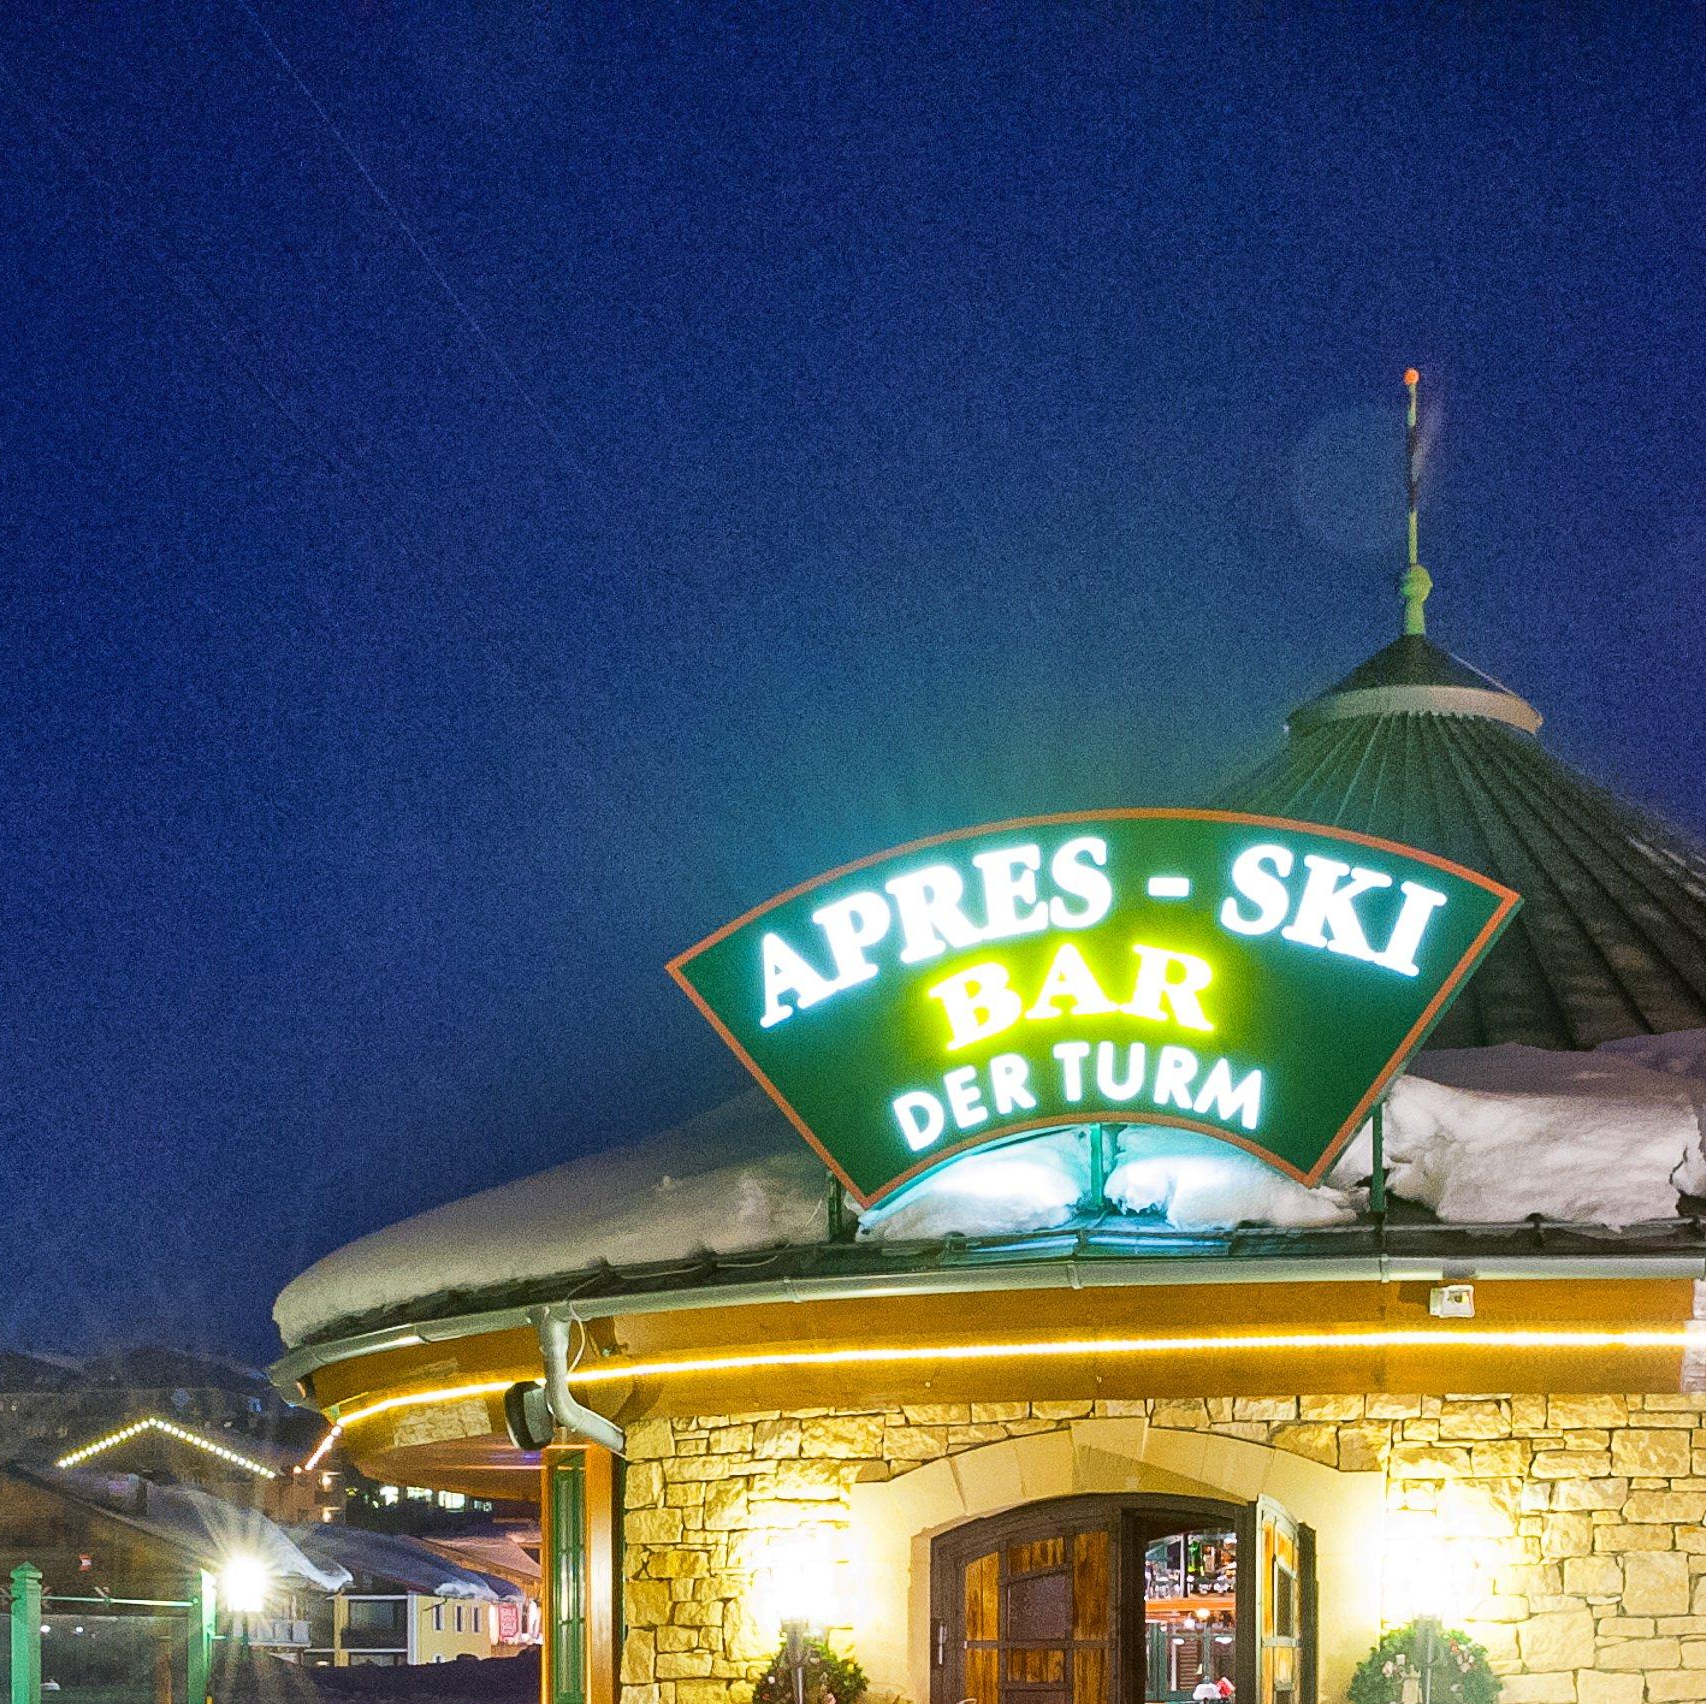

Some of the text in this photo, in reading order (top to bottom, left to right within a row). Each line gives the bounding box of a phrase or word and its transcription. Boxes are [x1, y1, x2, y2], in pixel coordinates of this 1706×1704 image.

[760, 836, 1112, 1029] APRES
[1220, 843, 1448, 977] SKI
[928, 942, 1215, 1052] BAR
[894, 1041, 1264, 1153] DER TURM
